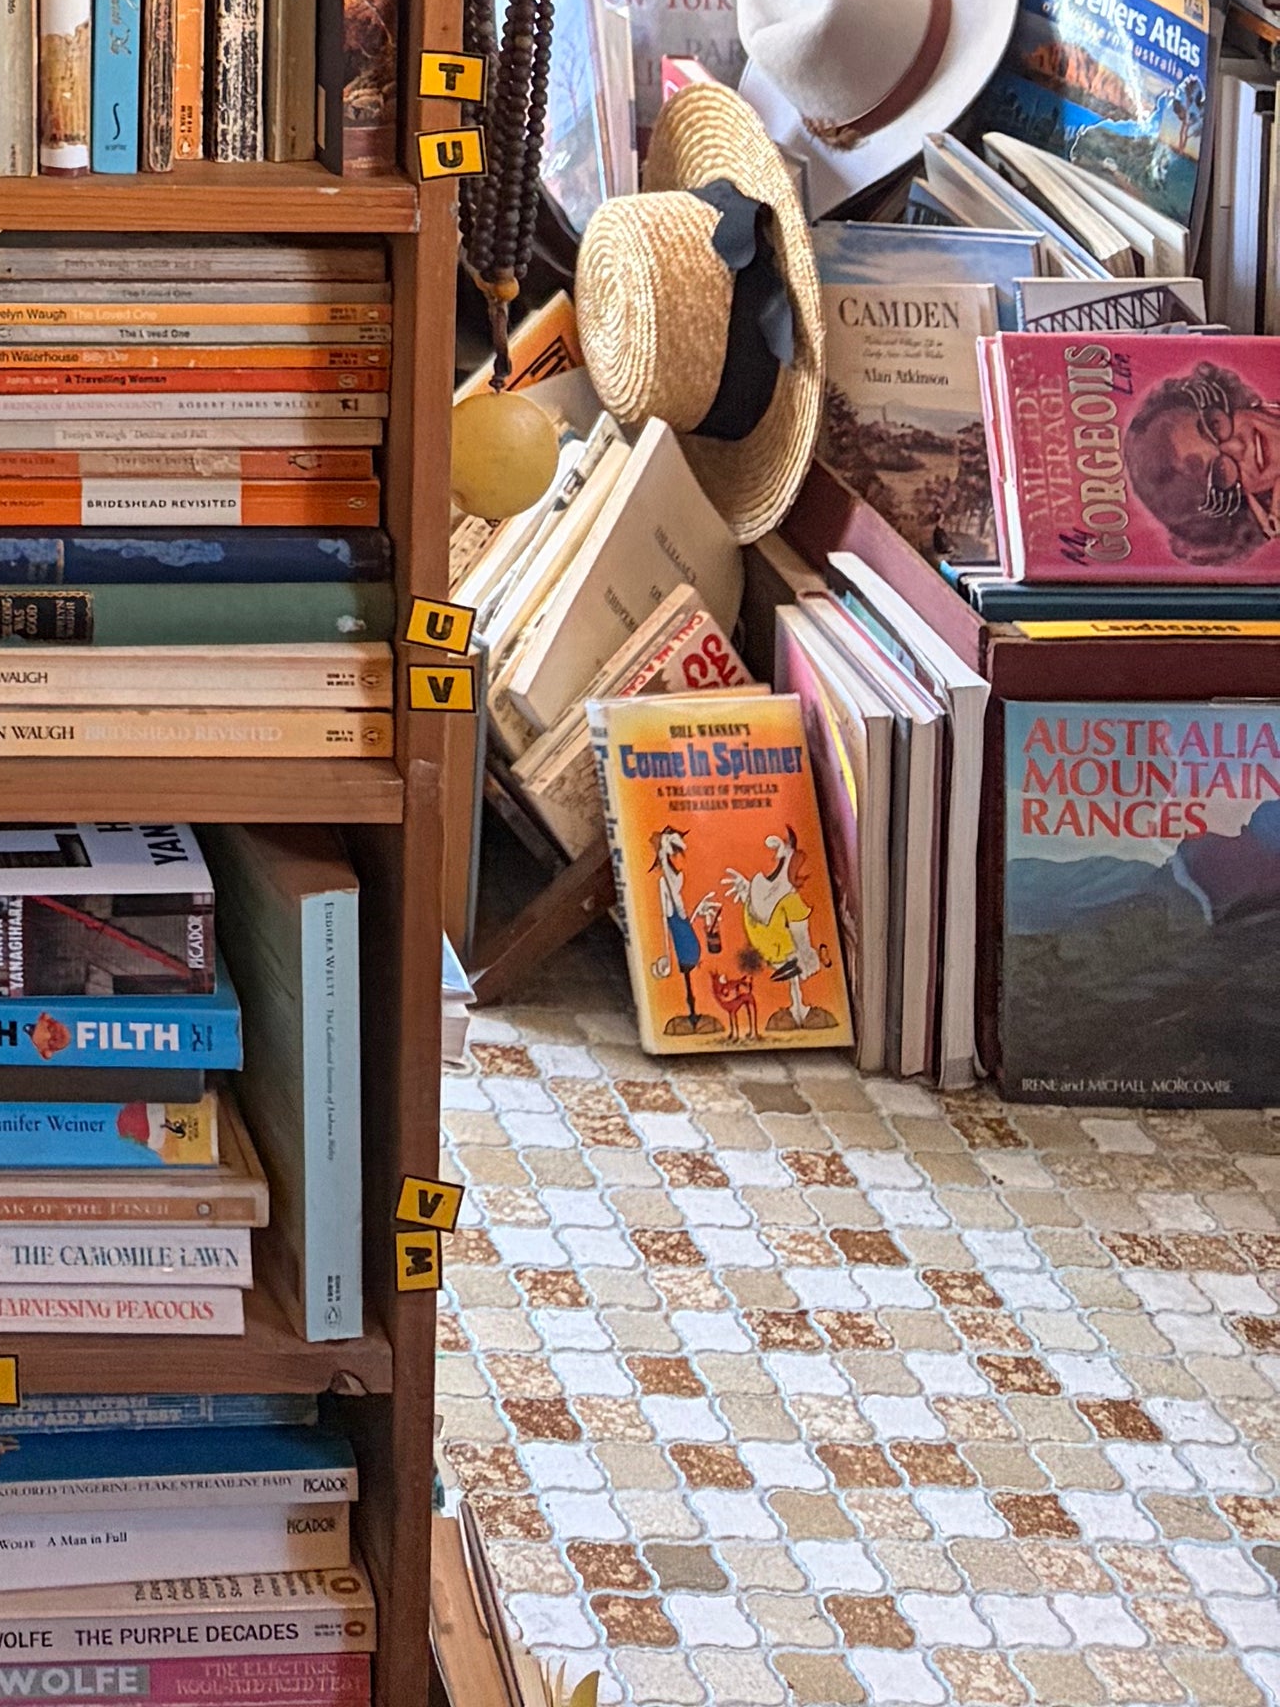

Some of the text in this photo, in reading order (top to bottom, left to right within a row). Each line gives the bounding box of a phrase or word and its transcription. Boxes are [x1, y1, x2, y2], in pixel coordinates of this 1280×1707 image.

[1148, 20, 1200, 65] Atlas
[436, 139, 463, 170] U
[840, 298, 959, 328] CAMDEN
[862, 368, 948, 386] Alan Atkinson
[86, 498, 236, 510] BRIDESHEAD REVISITED
[428, 675, 454, 703] V
[1024, 718, 1280, 759] AUSTRALIA
[714, 743, 803, 777] Spinner
[1022, 798, 1208, 839] RANGES
[76, 1022, 181, 1052] FILTH
[47, 1114, 106, 1134] Weiner
[74, 1627, 113, 1647] THE
[120, 1624, 199, 1647] PURPLE
[206, 1622, 300, 1644] DECADES
